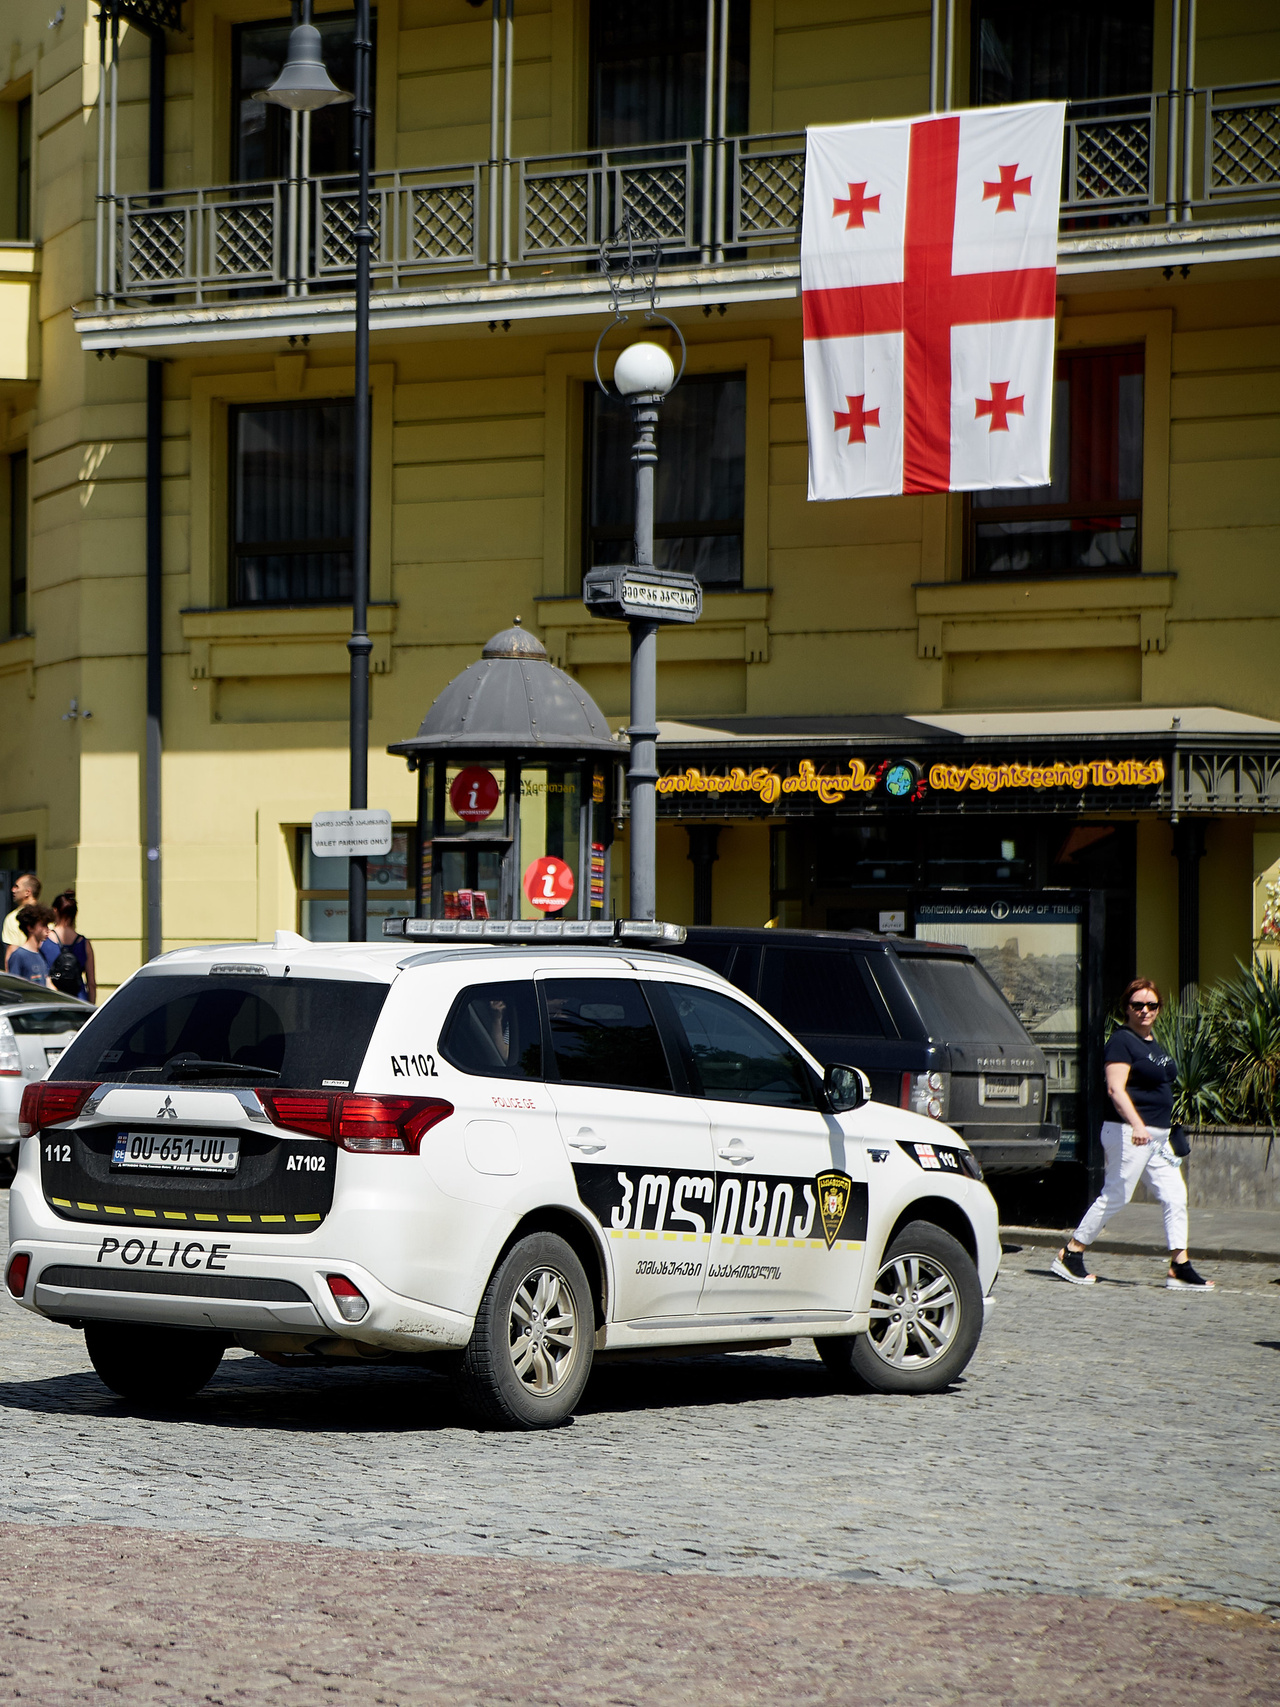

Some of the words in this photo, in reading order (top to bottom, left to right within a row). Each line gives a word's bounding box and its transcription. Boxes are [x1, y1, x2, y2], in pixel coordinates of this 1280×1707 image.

[930, 764, 969, 791] City
[969, 763, 1089, 792] Sightseeing
[1088, 760, 1164, 788] Tbilisi
[1012, 905, 1034, 915] MAP
[1036, 905, 1050, 914] OF
[391, 1054, 439, 1077] A7102
[977, 1058, 1007, 1066] RANGE
[491, 1096, 536, 1110] POLICE.GE
[45, 1144, 71, 1162] 112
[114, 1149, 125, 1159] GE
[130, 1136, 225, 1164] OU-651-UU
[286, 1155, 326, 1171] A7102
[939, 1151, 958, 1168] 112
[611, 1172, 816, 1239] პოლიცია
[96, 1237, 231, 1271] POLICE
